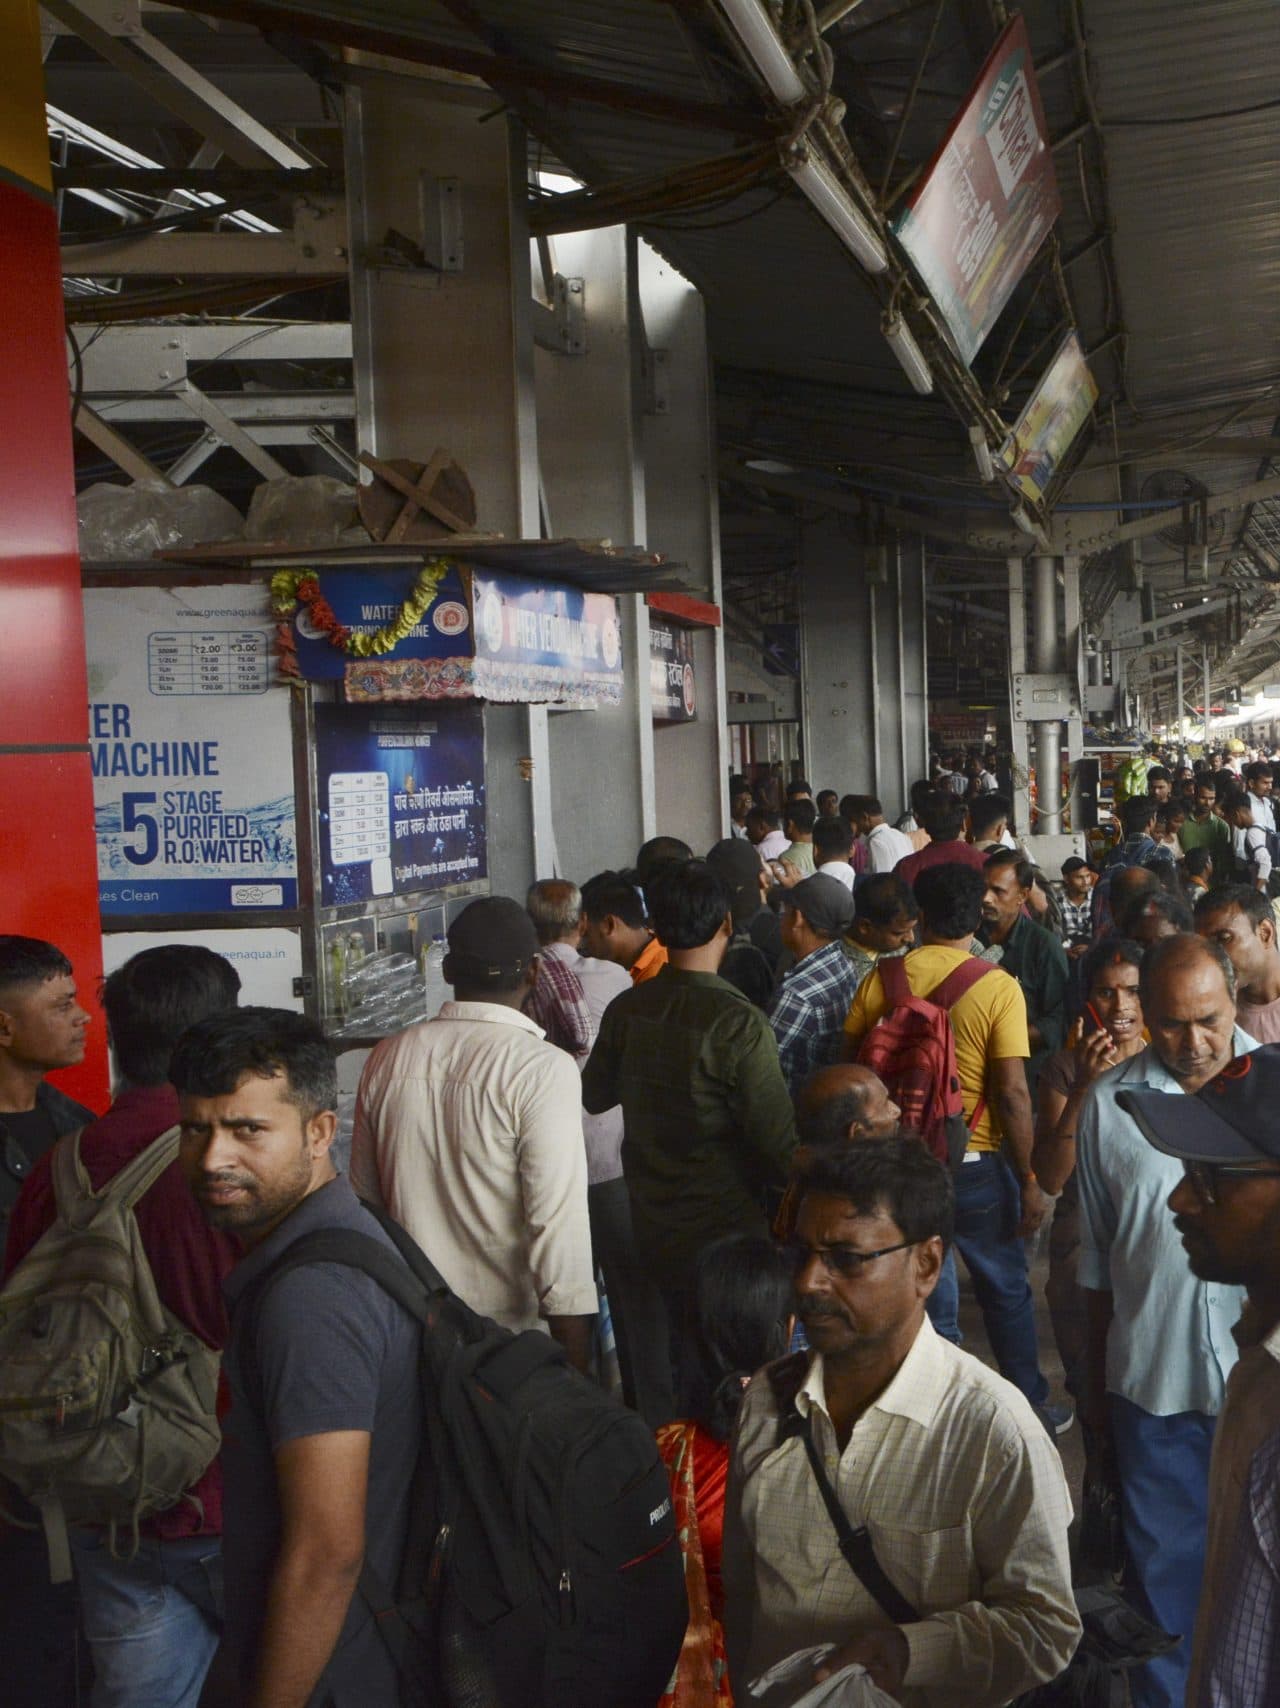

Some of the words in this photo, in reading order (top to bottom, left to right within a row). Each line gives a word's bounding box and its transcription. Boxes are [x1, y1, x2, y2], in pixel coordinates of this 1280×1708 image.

[91, 742, 219, 777] MACHINE
[163, 790, 223, 815] STAGE
[122, 792, 159, 866] 5
[164, 815, 248, 839] PURIFIED
[121, 889, 159, 902] Clean
